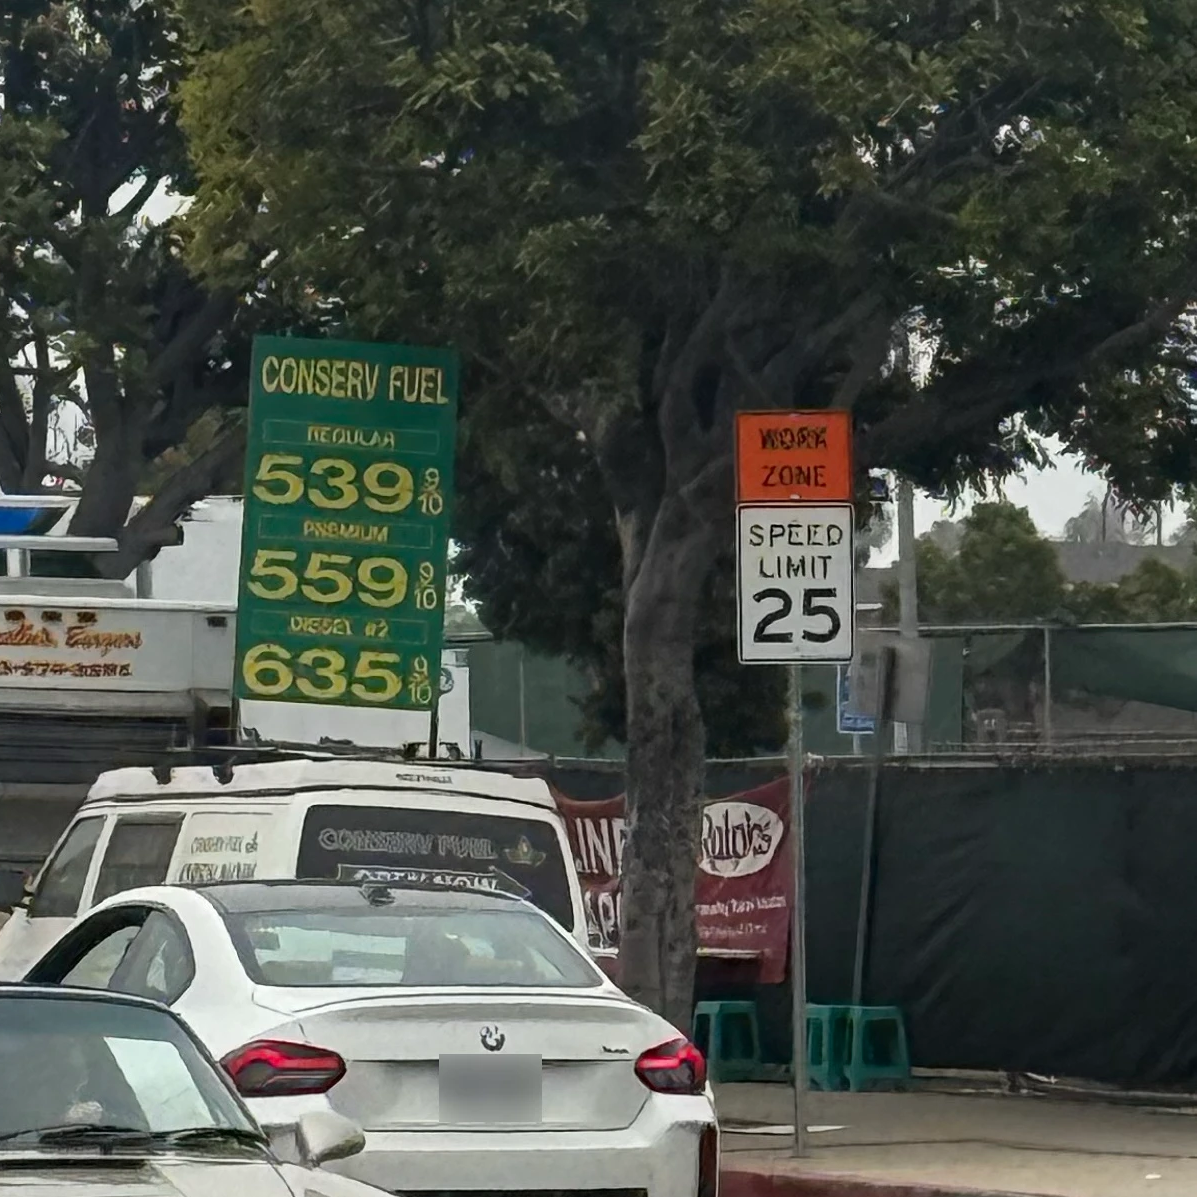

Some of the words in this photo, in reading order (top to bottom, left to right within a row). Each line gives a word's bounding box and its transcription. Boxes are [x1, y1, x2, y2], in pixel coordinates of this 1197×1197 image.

[262, 356, 379, 400] CONSERV
[389, 366, 449, 404] FUEL
[307, 424, 395, 450] REGULAR
[760, 427, 827, 449] WORK
[253, 454, 414, 513] 539
[762, 465, 826, 487] ZONE
[303, 520, 389, 543] PREMIUM
[749, 524, 843, 547] SPEED
[247, 549, 408, 608] 559
[760, 556, 832, 579] LIMIT
[753, 588, 841, 643] 25
[242, 643, 403, 702] 635
